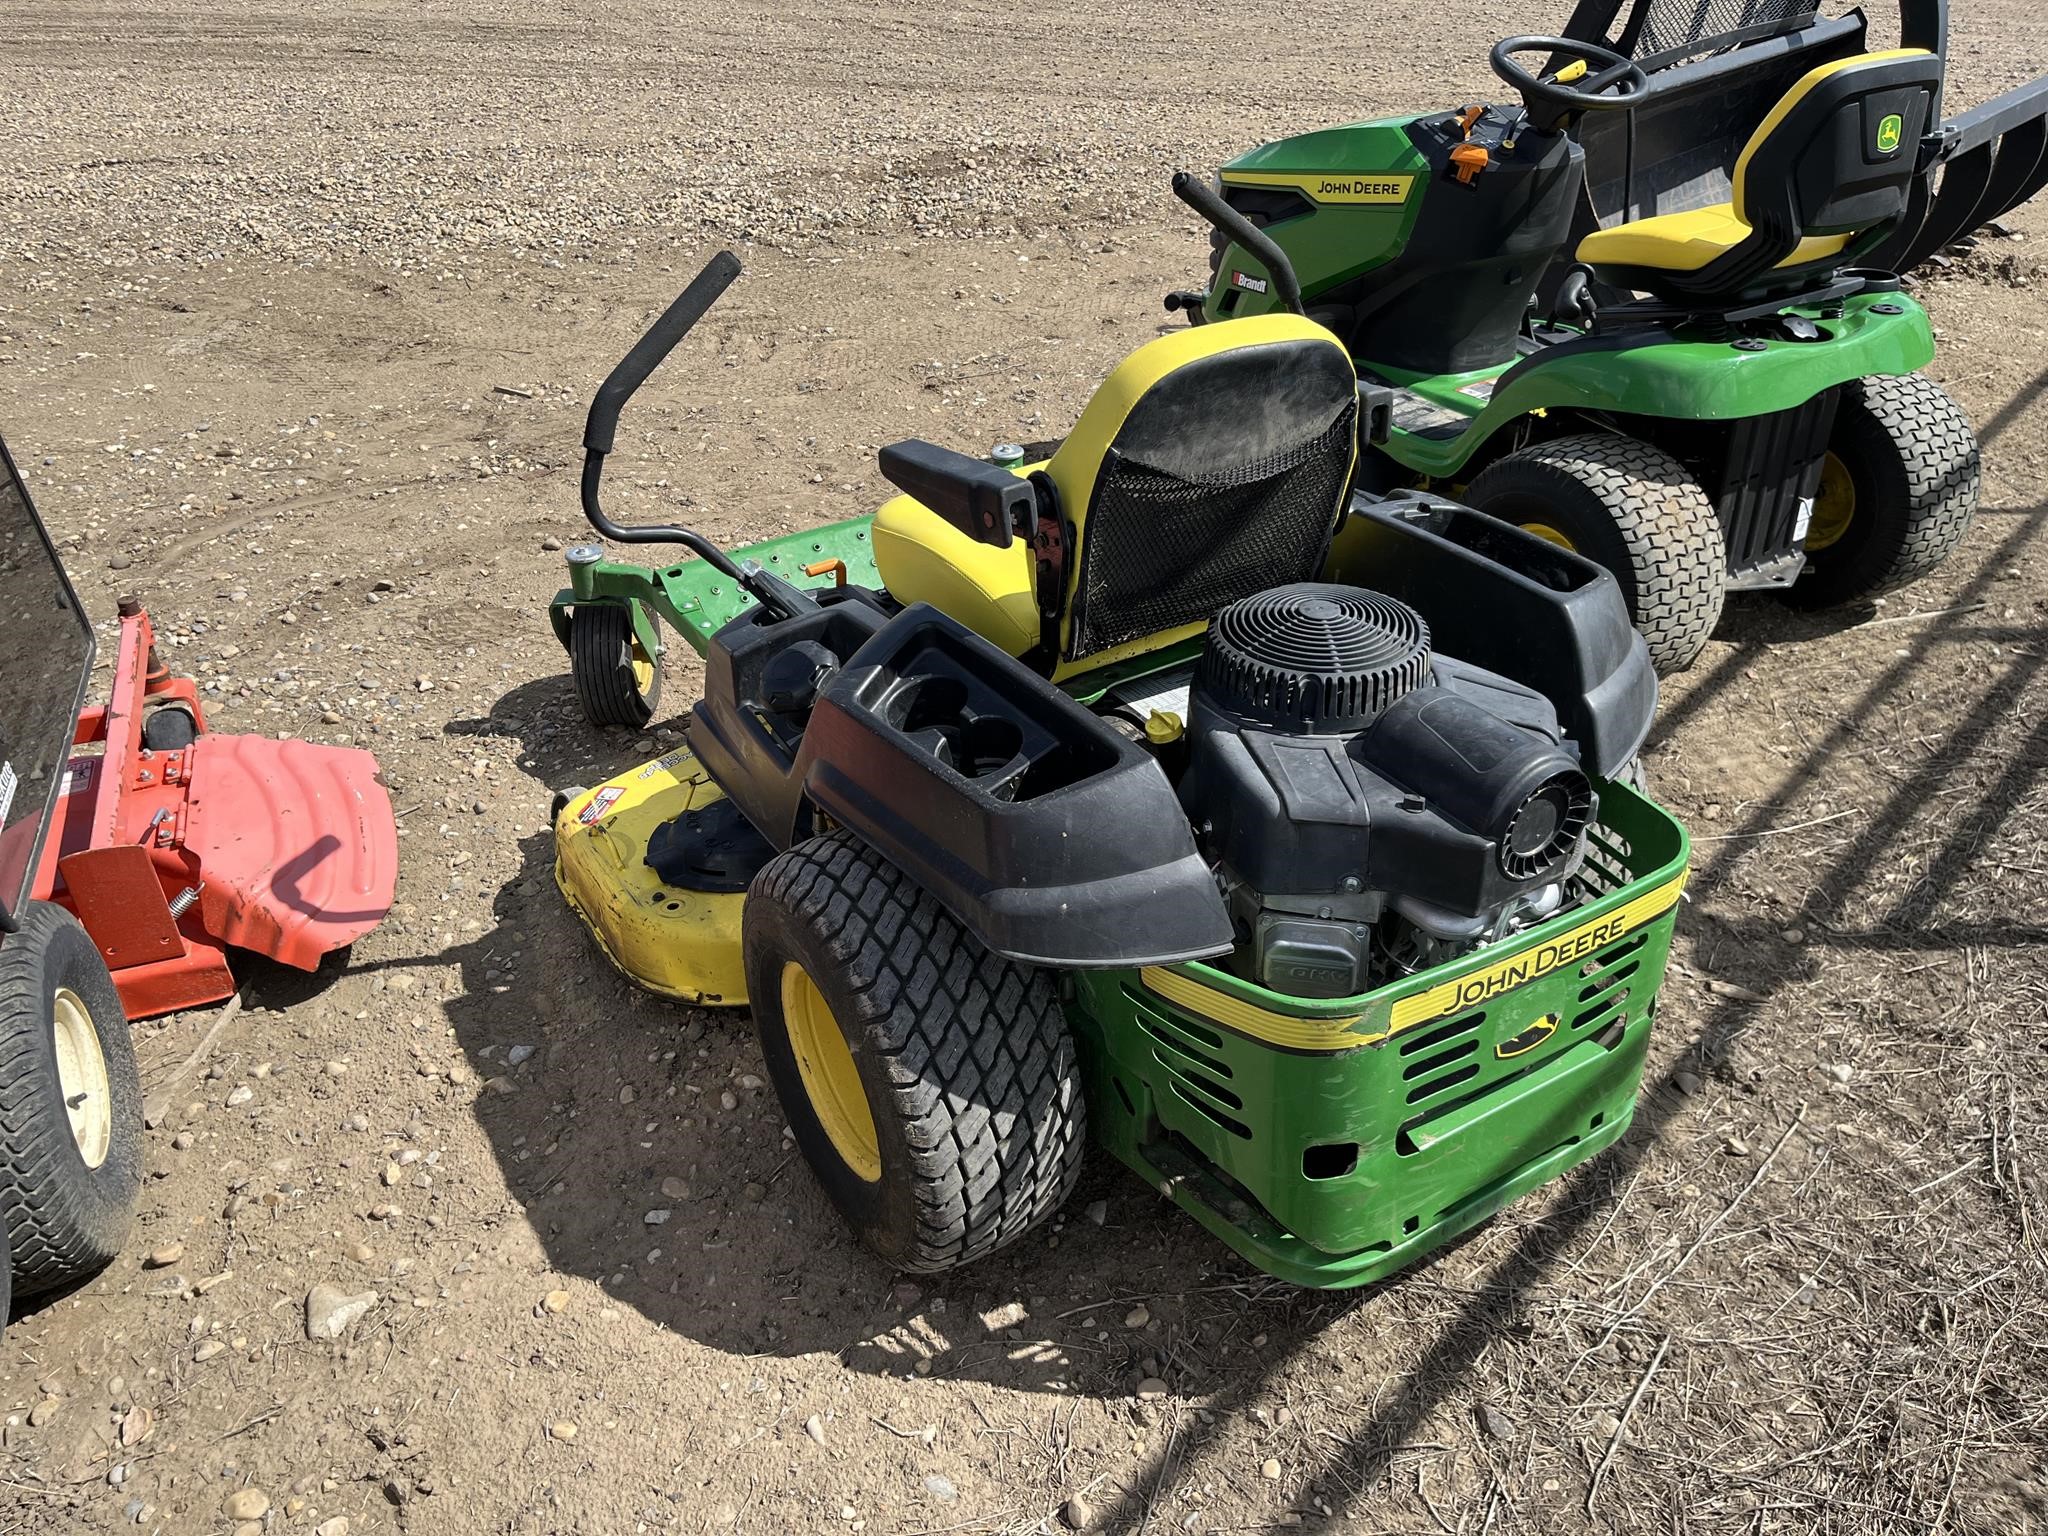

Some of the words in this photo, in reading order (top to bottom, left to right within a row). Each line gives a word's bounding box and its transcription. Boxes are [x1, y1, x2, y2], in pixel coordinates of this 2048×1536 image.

[1318, 181, 1351, 194] JOHN
[1354, 181, 1400, 195] DEERE
[1238, 273, 1267, 293] Brandt
[1444, 961, 1528, 1013] JOHN
[1535, 915, 1626, 974] DEERE
